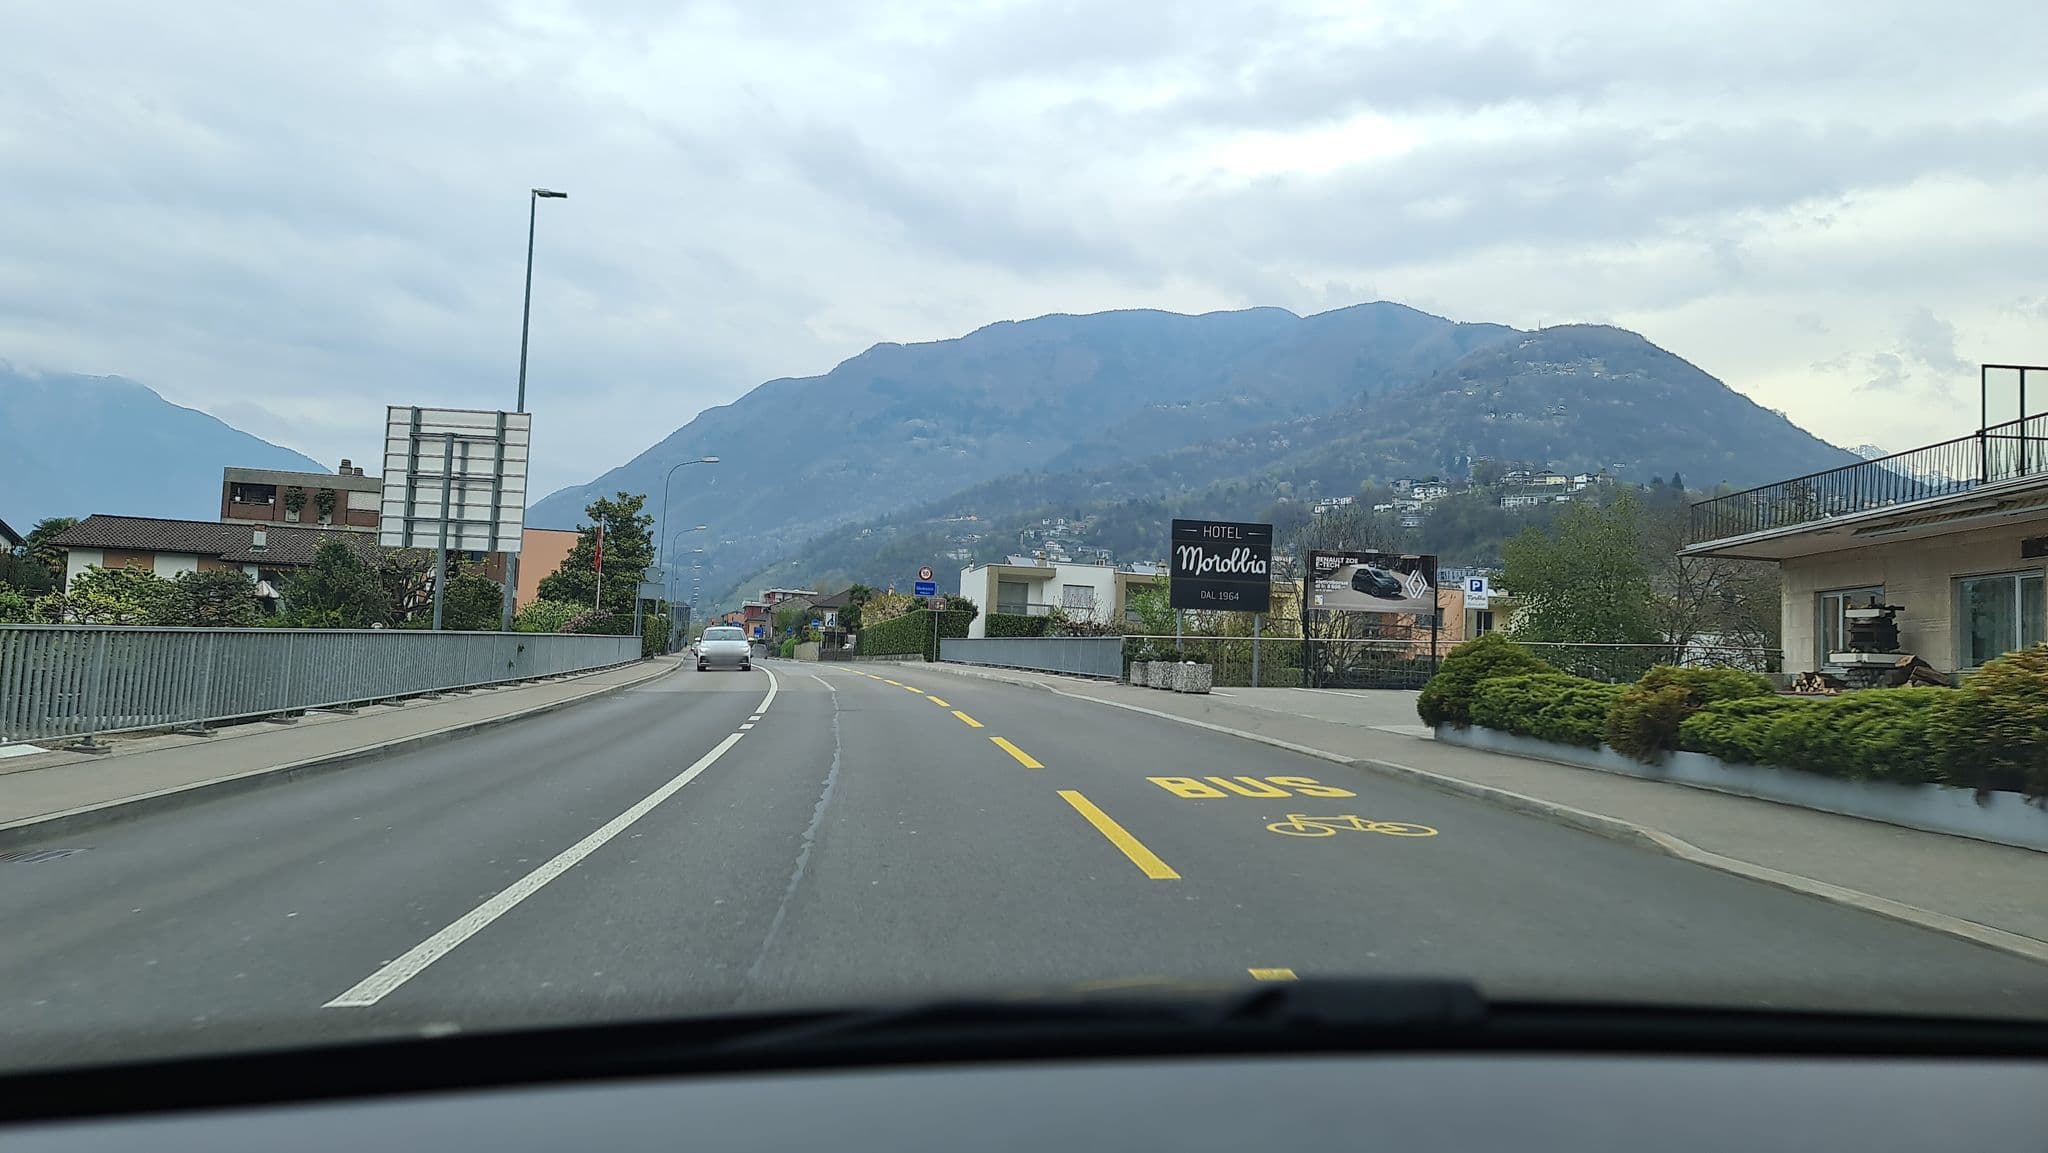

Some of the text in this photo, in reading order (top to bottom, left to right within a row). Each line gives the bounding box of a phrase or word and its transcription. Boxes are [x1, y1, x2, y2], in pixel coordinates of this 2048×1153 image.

[1203, 525, 1242, 539] HOTEL
[1176, 544, 1267, 576] Morobbia
[1315, 556, 1344, 564] RENAULT
[1472, 581, 1480, 590] P
[1200, 590, 1239, 601] DAL 1964
[1145, 776, 1357, 799] BUS
